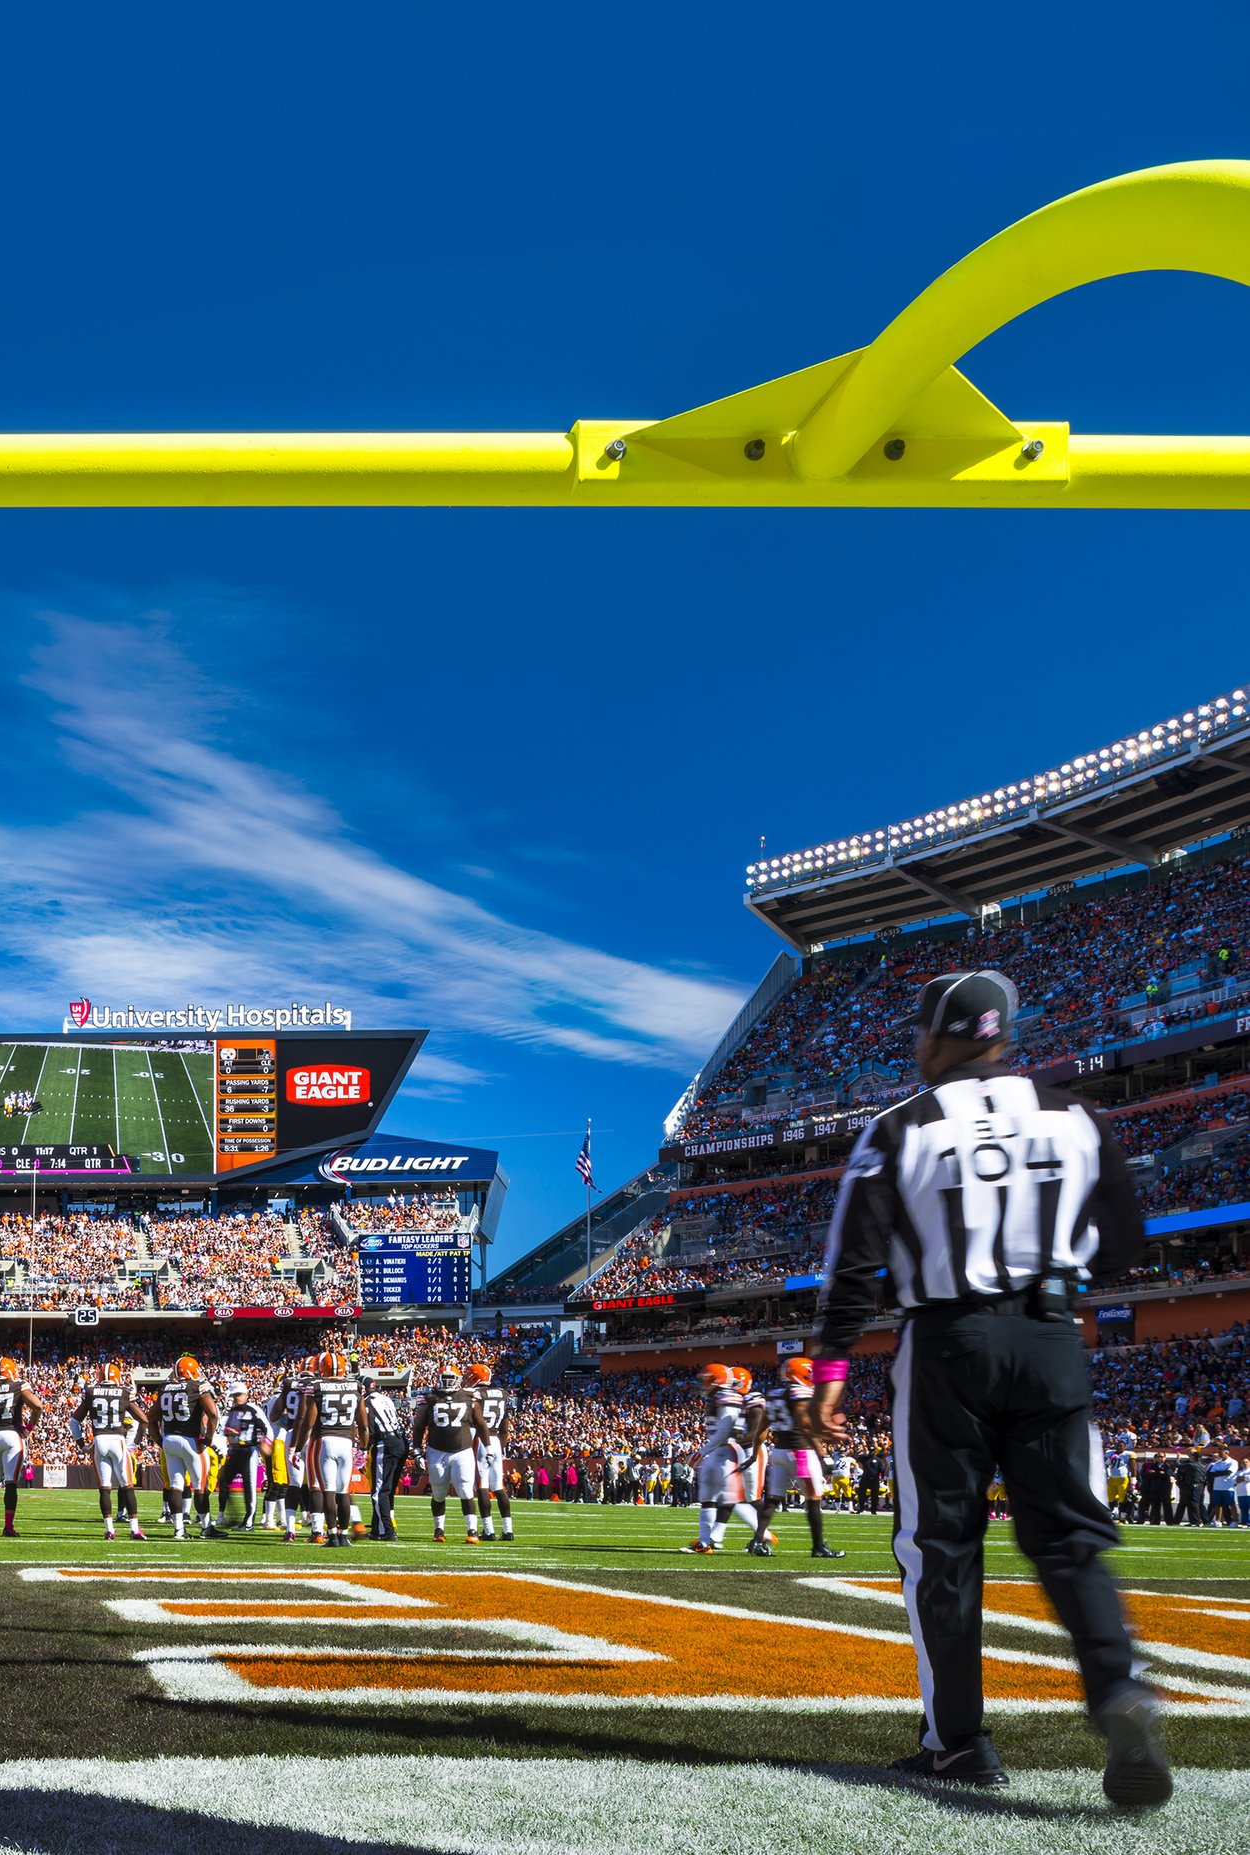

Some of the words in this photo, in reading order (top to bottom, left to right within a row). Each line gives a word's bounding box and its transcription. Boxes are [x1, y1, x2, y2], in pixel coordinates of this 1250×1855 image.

[92, 1004, 221, 1032] University
[227, 1002, 345, 1031] Hospitals
[1075, 1055, 1104, 1074] 7:14
[294, 1072, 362, 1085] GIANT
[295, 1086, 360, 1099] EAGLE
[684, 1133, 774, 1157] CHAMPIONSHIPS
[783, 1129, 805, 1143] 1946
[814, 1122, 837, 1137] 1947
[847, 1115, 872, 1130] 1948
[11, 1147, 18, 1155] 0
[35, 1147, 54, 1155] 11:17
[69, 1147, 87, 1155] QTR
[92, 1147, 97, 1155] 1
[152, 1152, 185, 1163] 30
[16, 1159, 31, 1169] CLE
[50, 1159, 66, 1169] 7:14
[85, 1159, 101, 1169] QTR
[110, 1159, 115, 1169] 1
[388, 1236, 422, 1244] FANTASY
[423, 1235, 454, 1243] LEADERS
[592, 1298, 635, 1311] GIANT
[637, 1295, 675, 1307] EAGLE
[80, 1311, 96, 1322] 25
[93, 1388, 122, 1397] WHITNER
[320, 1382, 358, 1392] ROBERTSON
[160, 1392, 190, 1421] 93
[320, 1394, 358, 1426] 53
[92, 1398, 122, 1429] 31
[433, 1403, 467, 1427] 67
[483, 1400, 505, 1429] 51
[835, 1460, 847, 1470] 72
